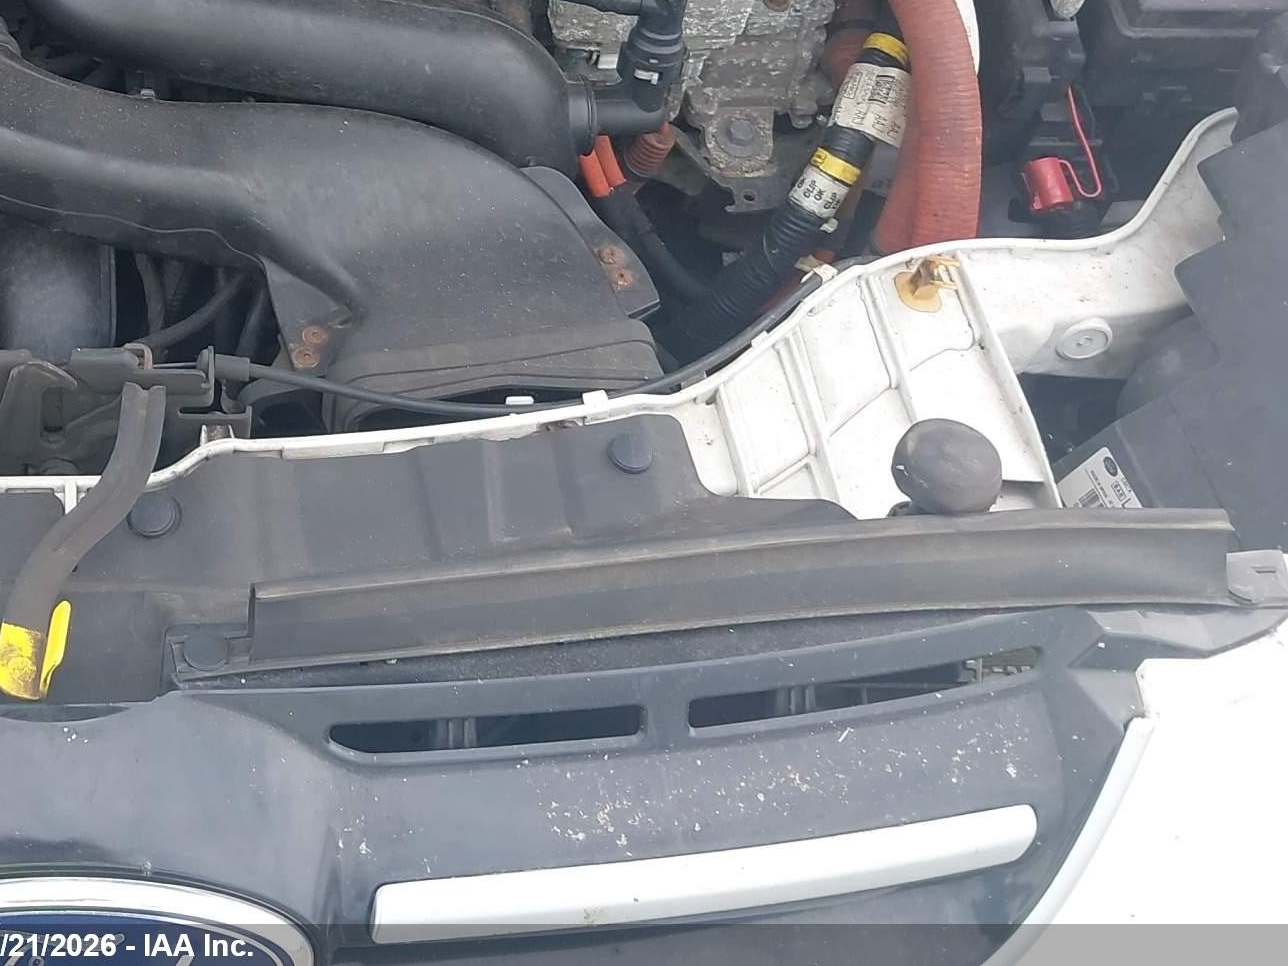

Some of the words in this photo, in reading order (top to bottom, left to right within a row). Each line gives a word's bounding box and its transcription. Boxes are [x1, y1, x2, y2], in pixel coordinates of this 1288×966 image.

[803, 180, 817, 200] CLIP
[815, 188, 825, 201] OK
[824, 192, 838, 210] CLIP
